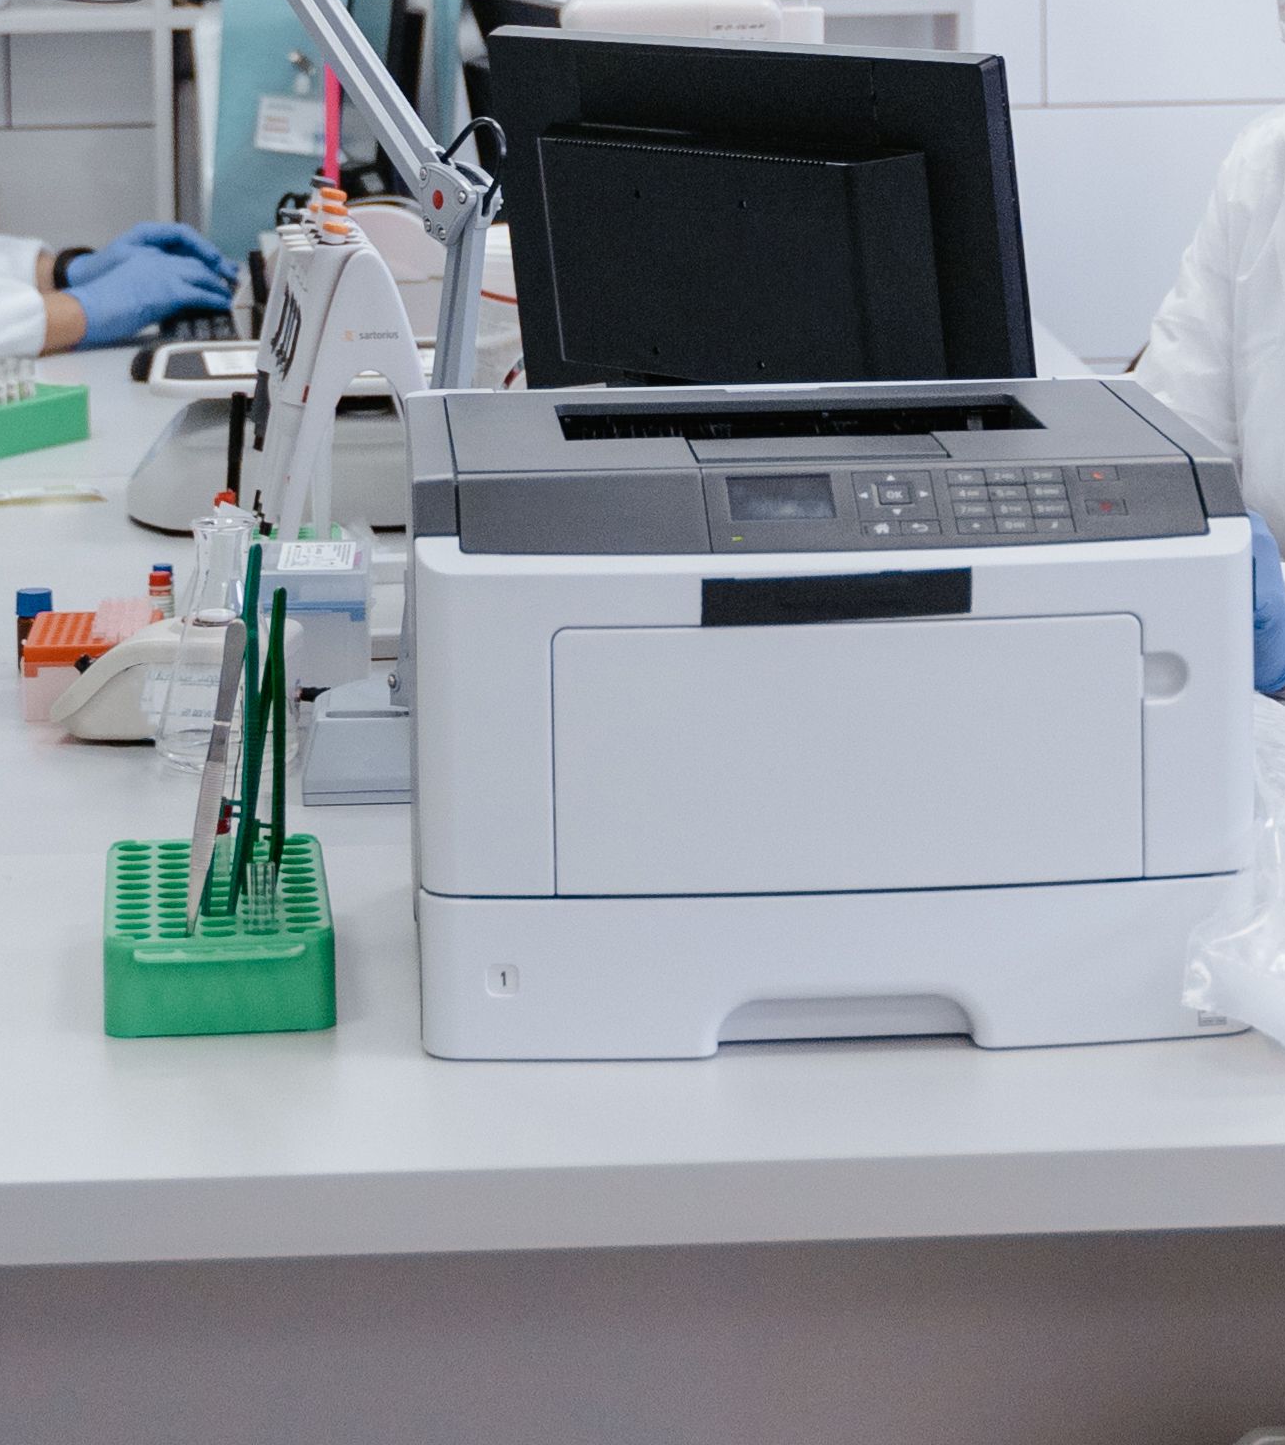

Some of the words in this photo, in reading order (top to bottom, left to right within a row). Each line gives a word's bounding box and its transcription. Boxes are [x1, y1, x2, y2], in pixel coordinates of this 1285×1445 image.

[358, 330, 399, 340] sartorius
[885, 490, 903, 499] OK
[500, 971, 506, 987] 1
